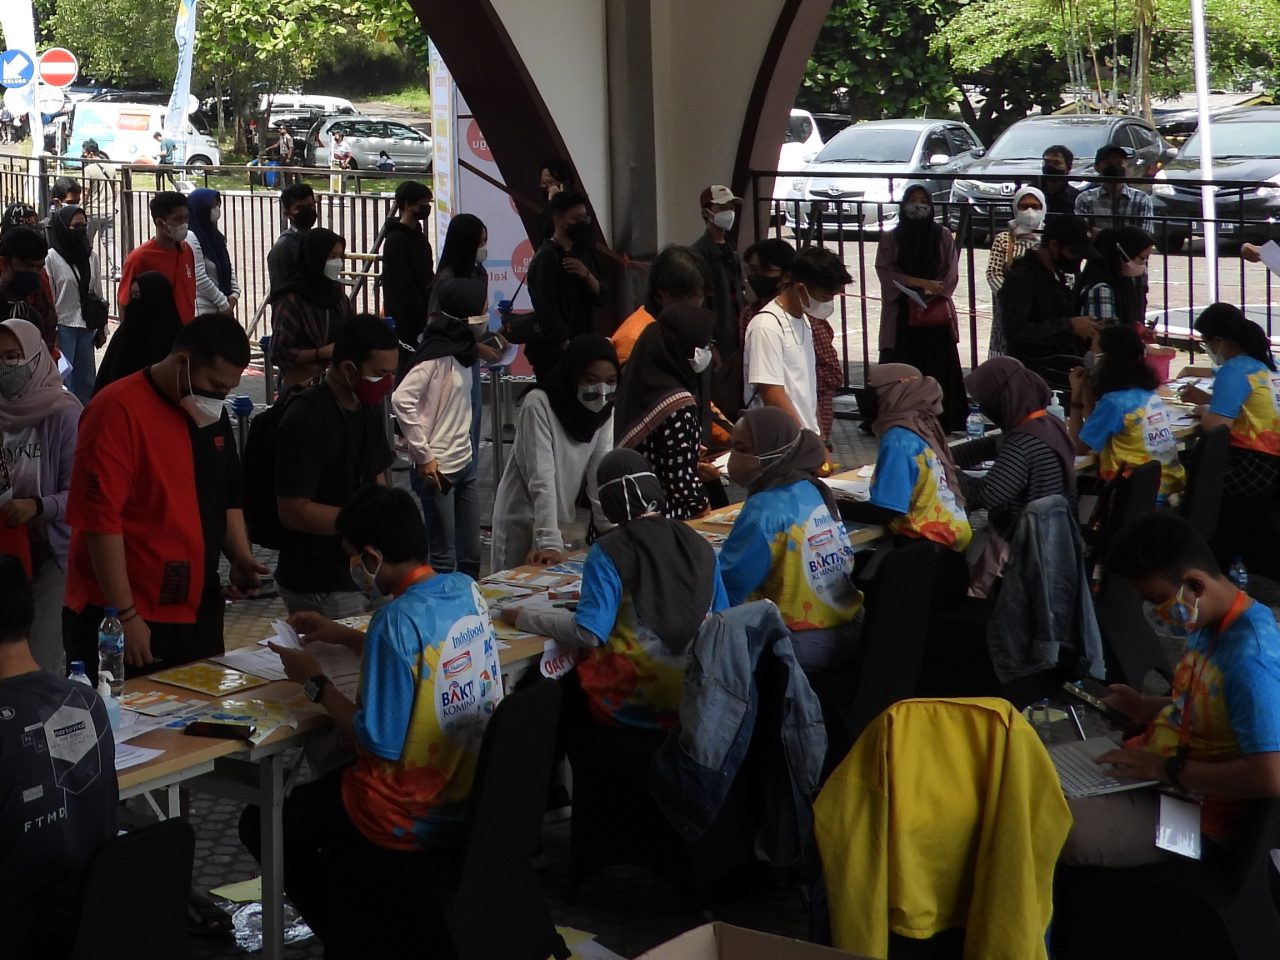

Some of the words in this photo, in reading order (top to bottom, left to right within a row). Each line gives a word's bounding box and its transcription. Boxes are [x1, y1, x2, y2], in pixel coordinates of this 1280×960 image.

[809, 551, 839, 573] BAKTI
[452, 621, 485, 649] Indofood
[24, 806, 65, 832] FTMD
